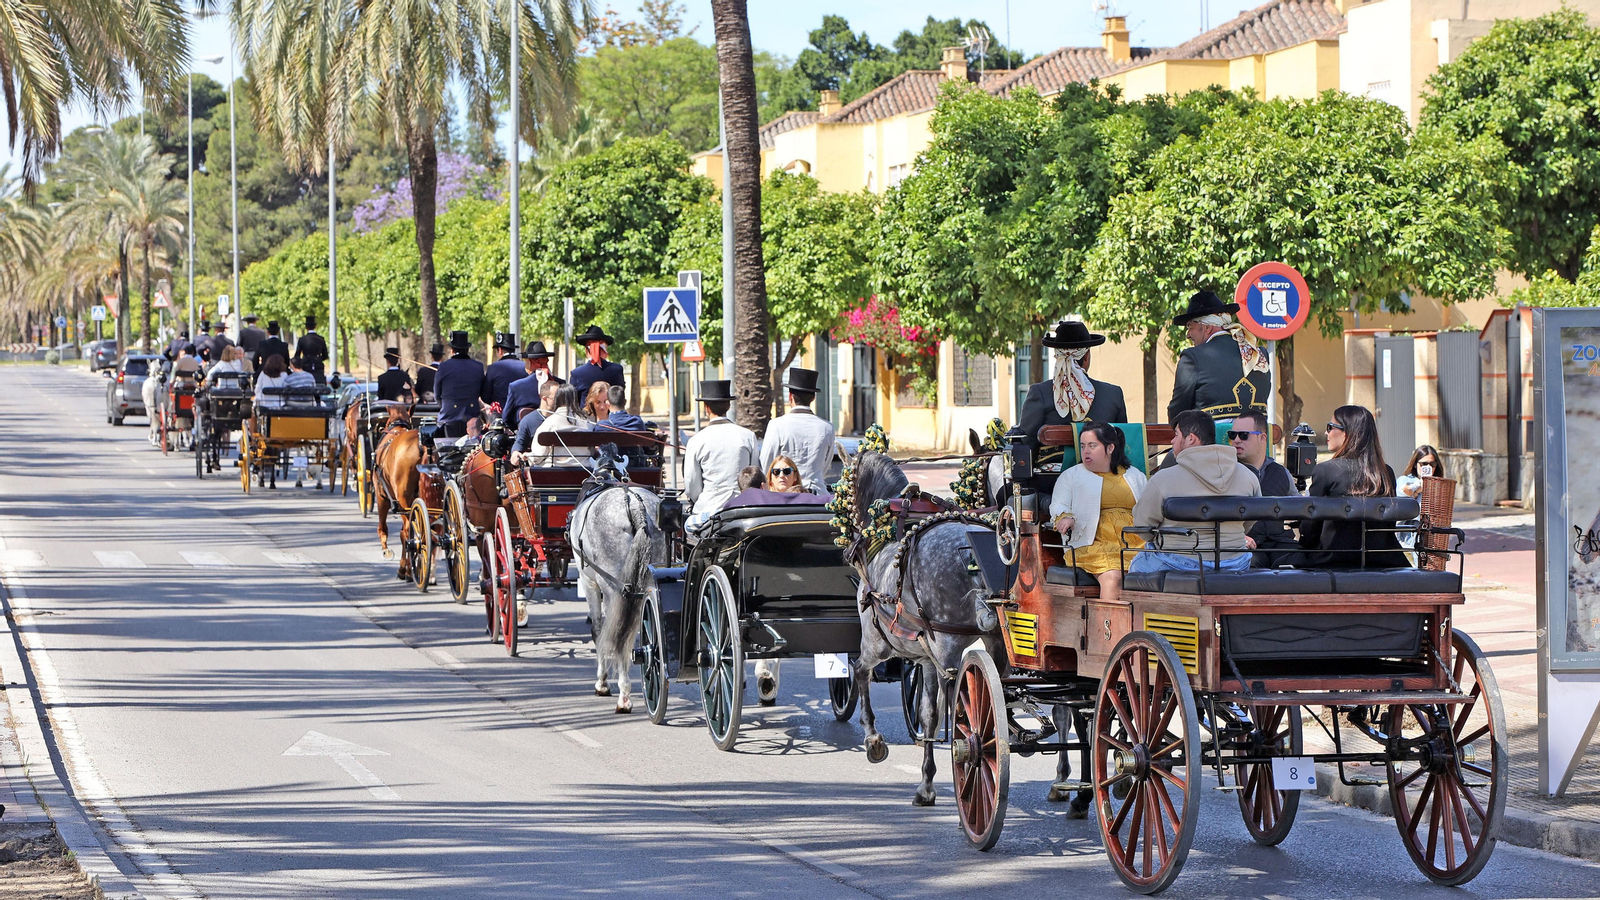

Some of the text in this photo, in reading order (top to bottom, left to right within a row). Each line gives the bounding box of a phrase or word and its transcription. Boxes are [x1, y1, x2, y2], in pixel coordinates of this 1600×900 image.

[1572, 344, 1600, 361] ZO
[828, 661, 834, 671] 7
[1290, 767, 1298, 780] 8
